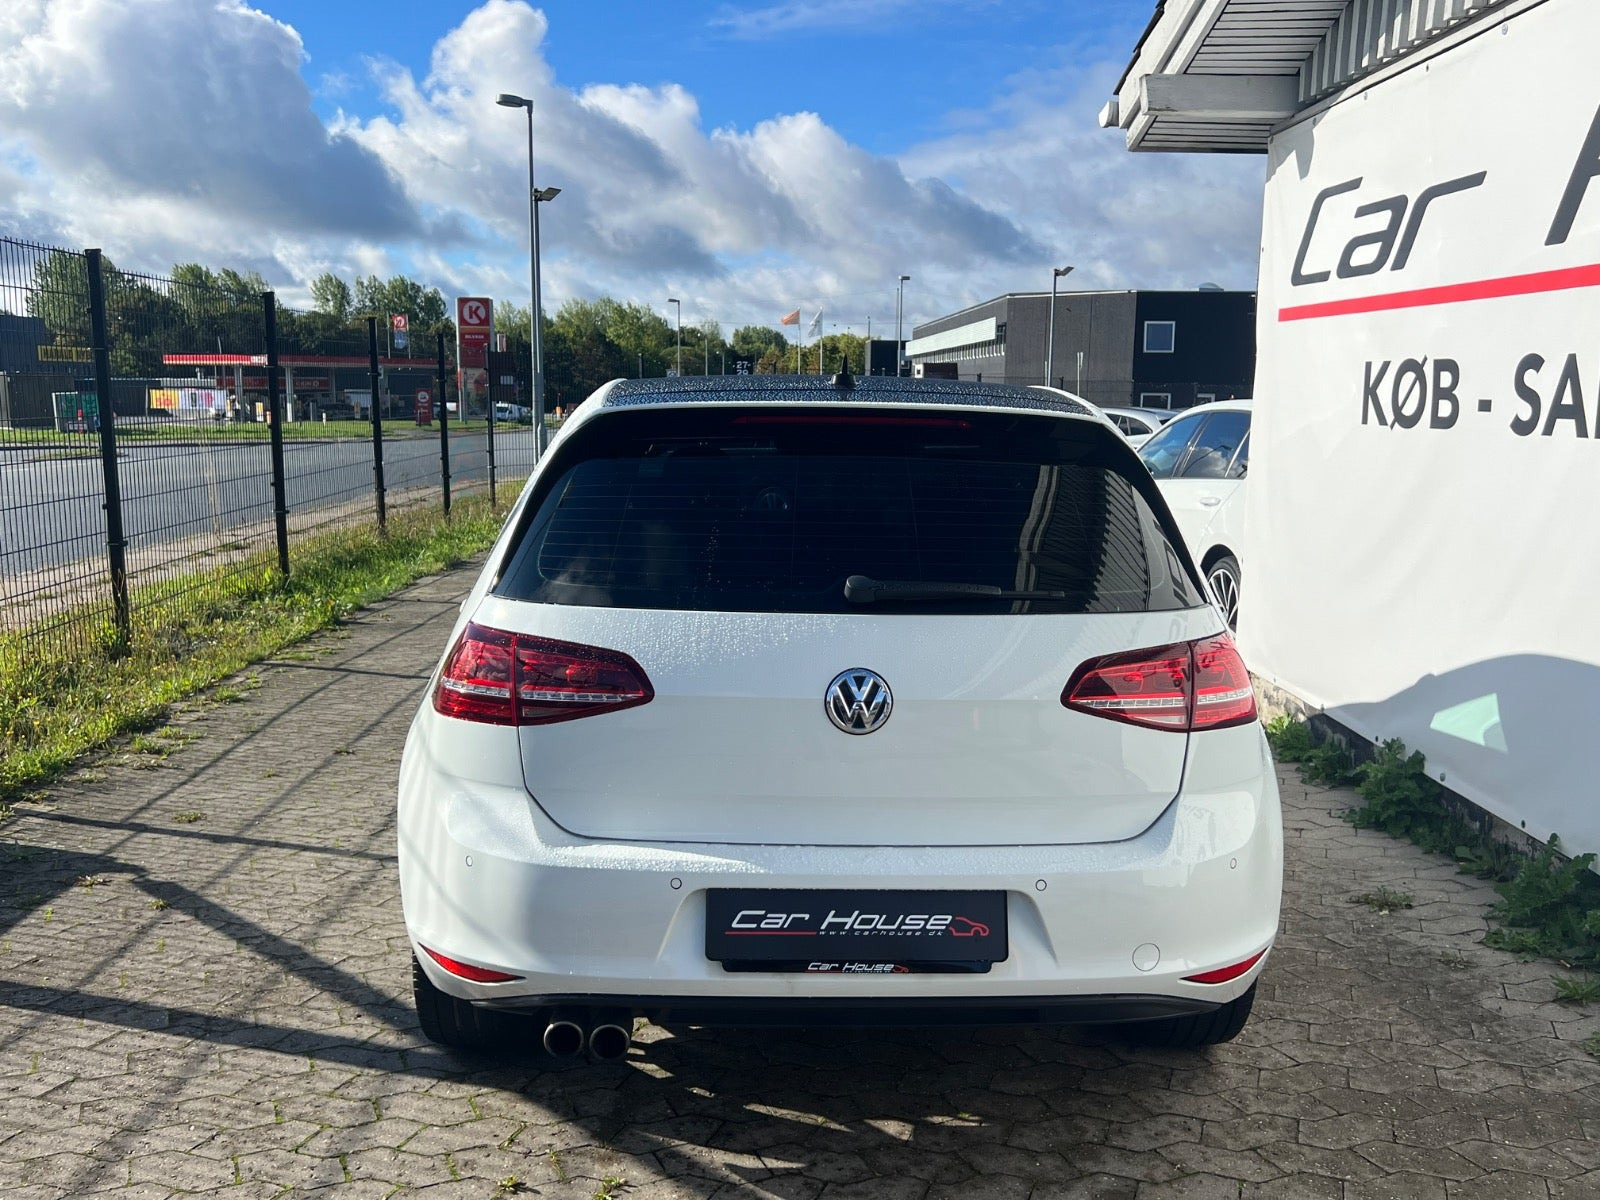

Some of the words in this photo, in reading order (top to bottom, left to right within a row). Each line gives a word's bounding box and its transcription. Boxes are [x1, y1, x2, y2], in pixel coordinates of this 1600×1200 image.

[1291, 170, 1488, 287] Car
[1361, 355, 1460, 431] KØB
[731, 909, 810, 929] Car
[820, 910, 952, 930] House
[819, 929, 944, 937] www.carhouse.dk
[807, 962, 839, 971] Car
[842, 962, 895, 971] House
